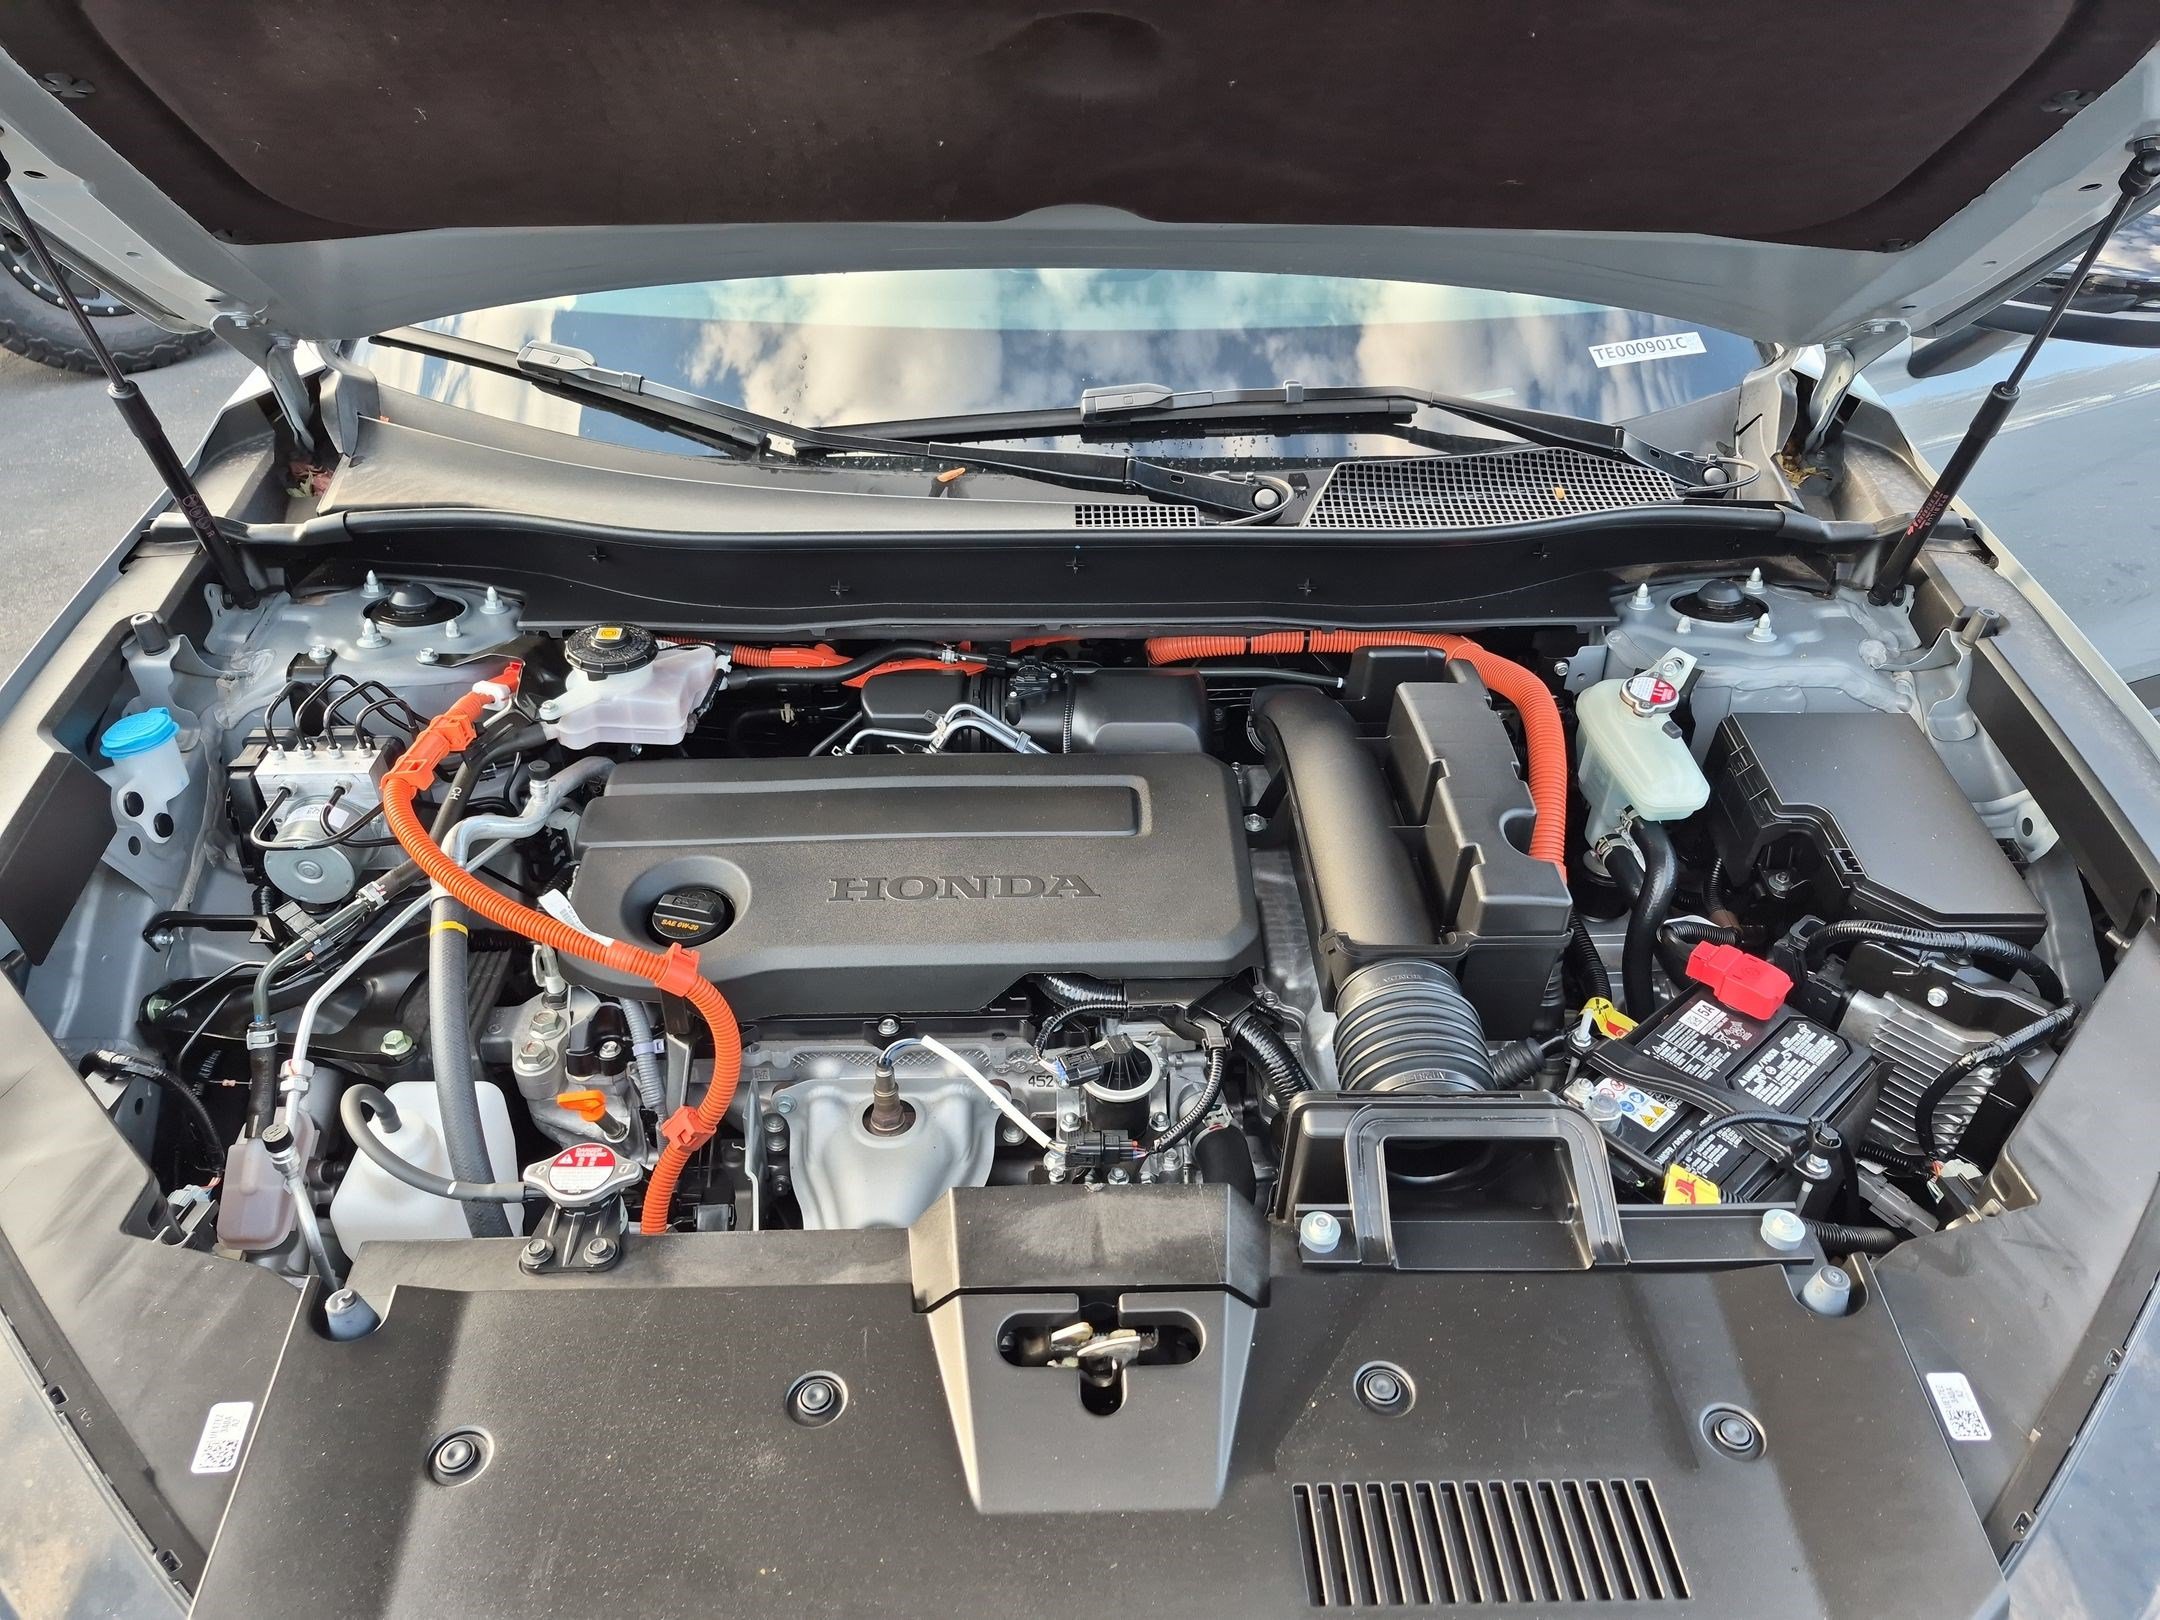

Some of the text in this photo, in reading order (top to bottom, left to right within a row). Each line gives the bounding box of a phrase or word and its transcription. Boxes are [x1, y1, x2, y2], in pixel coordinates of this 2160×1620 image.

[1593, 336, 1687, 361] TE000901C
[827, 875, 1101, 902] HONDA
[661, 919, 699, 931] SAE 0W-20
[1697, 1004, 1715, 1017] 5A
[1028, 1074, 1054, 1088] 452
